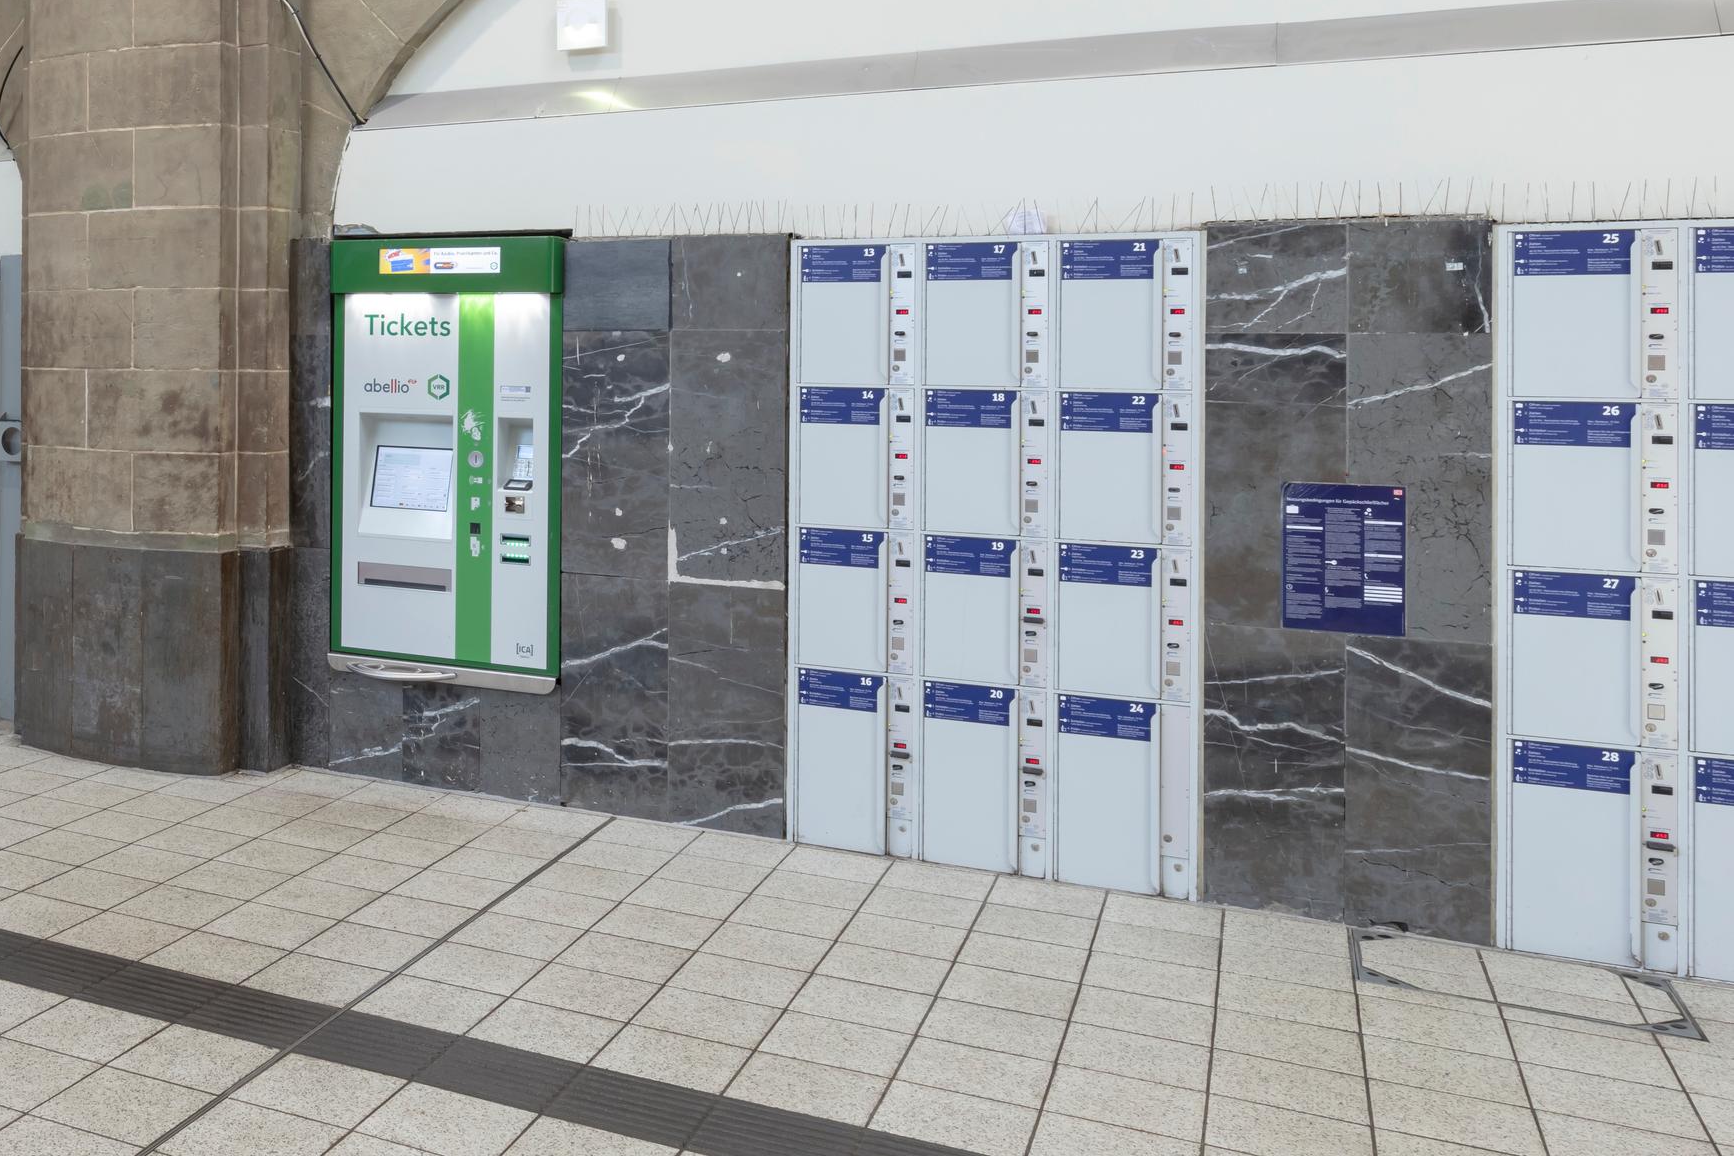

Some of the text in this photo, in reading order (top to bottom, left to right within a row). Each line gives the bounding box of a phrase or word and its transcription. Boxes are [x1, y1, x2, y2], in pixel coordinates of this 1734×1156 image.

[1602, 234, 1619, 243] 25
[993, 245, 1005, 254] 17
[1133, 243, 1146, 251] 21
[863, 248, 875, 257] 13
[364, 313, 451, 337] Tickets
[364, 379, 410, 394] abellio
[862, 391, 874, 399] 14
[992, 393, 1004, 401] 18
[1132, 396, 1145, 404] 22
[1602, 406, 1620, 415] 26
[862, 534, 874, 542] 15
[991, 542, 1004, 551] 19
[1131, 550, 1144, 559] 23
[1603, 578, 1620, 589] 27
[861, 678, 873, 686] 16
[990, 690, 1003, 699] 20
[1130, 704, 1143, 713] 24
[1602, 750, 1620, 762] 28
